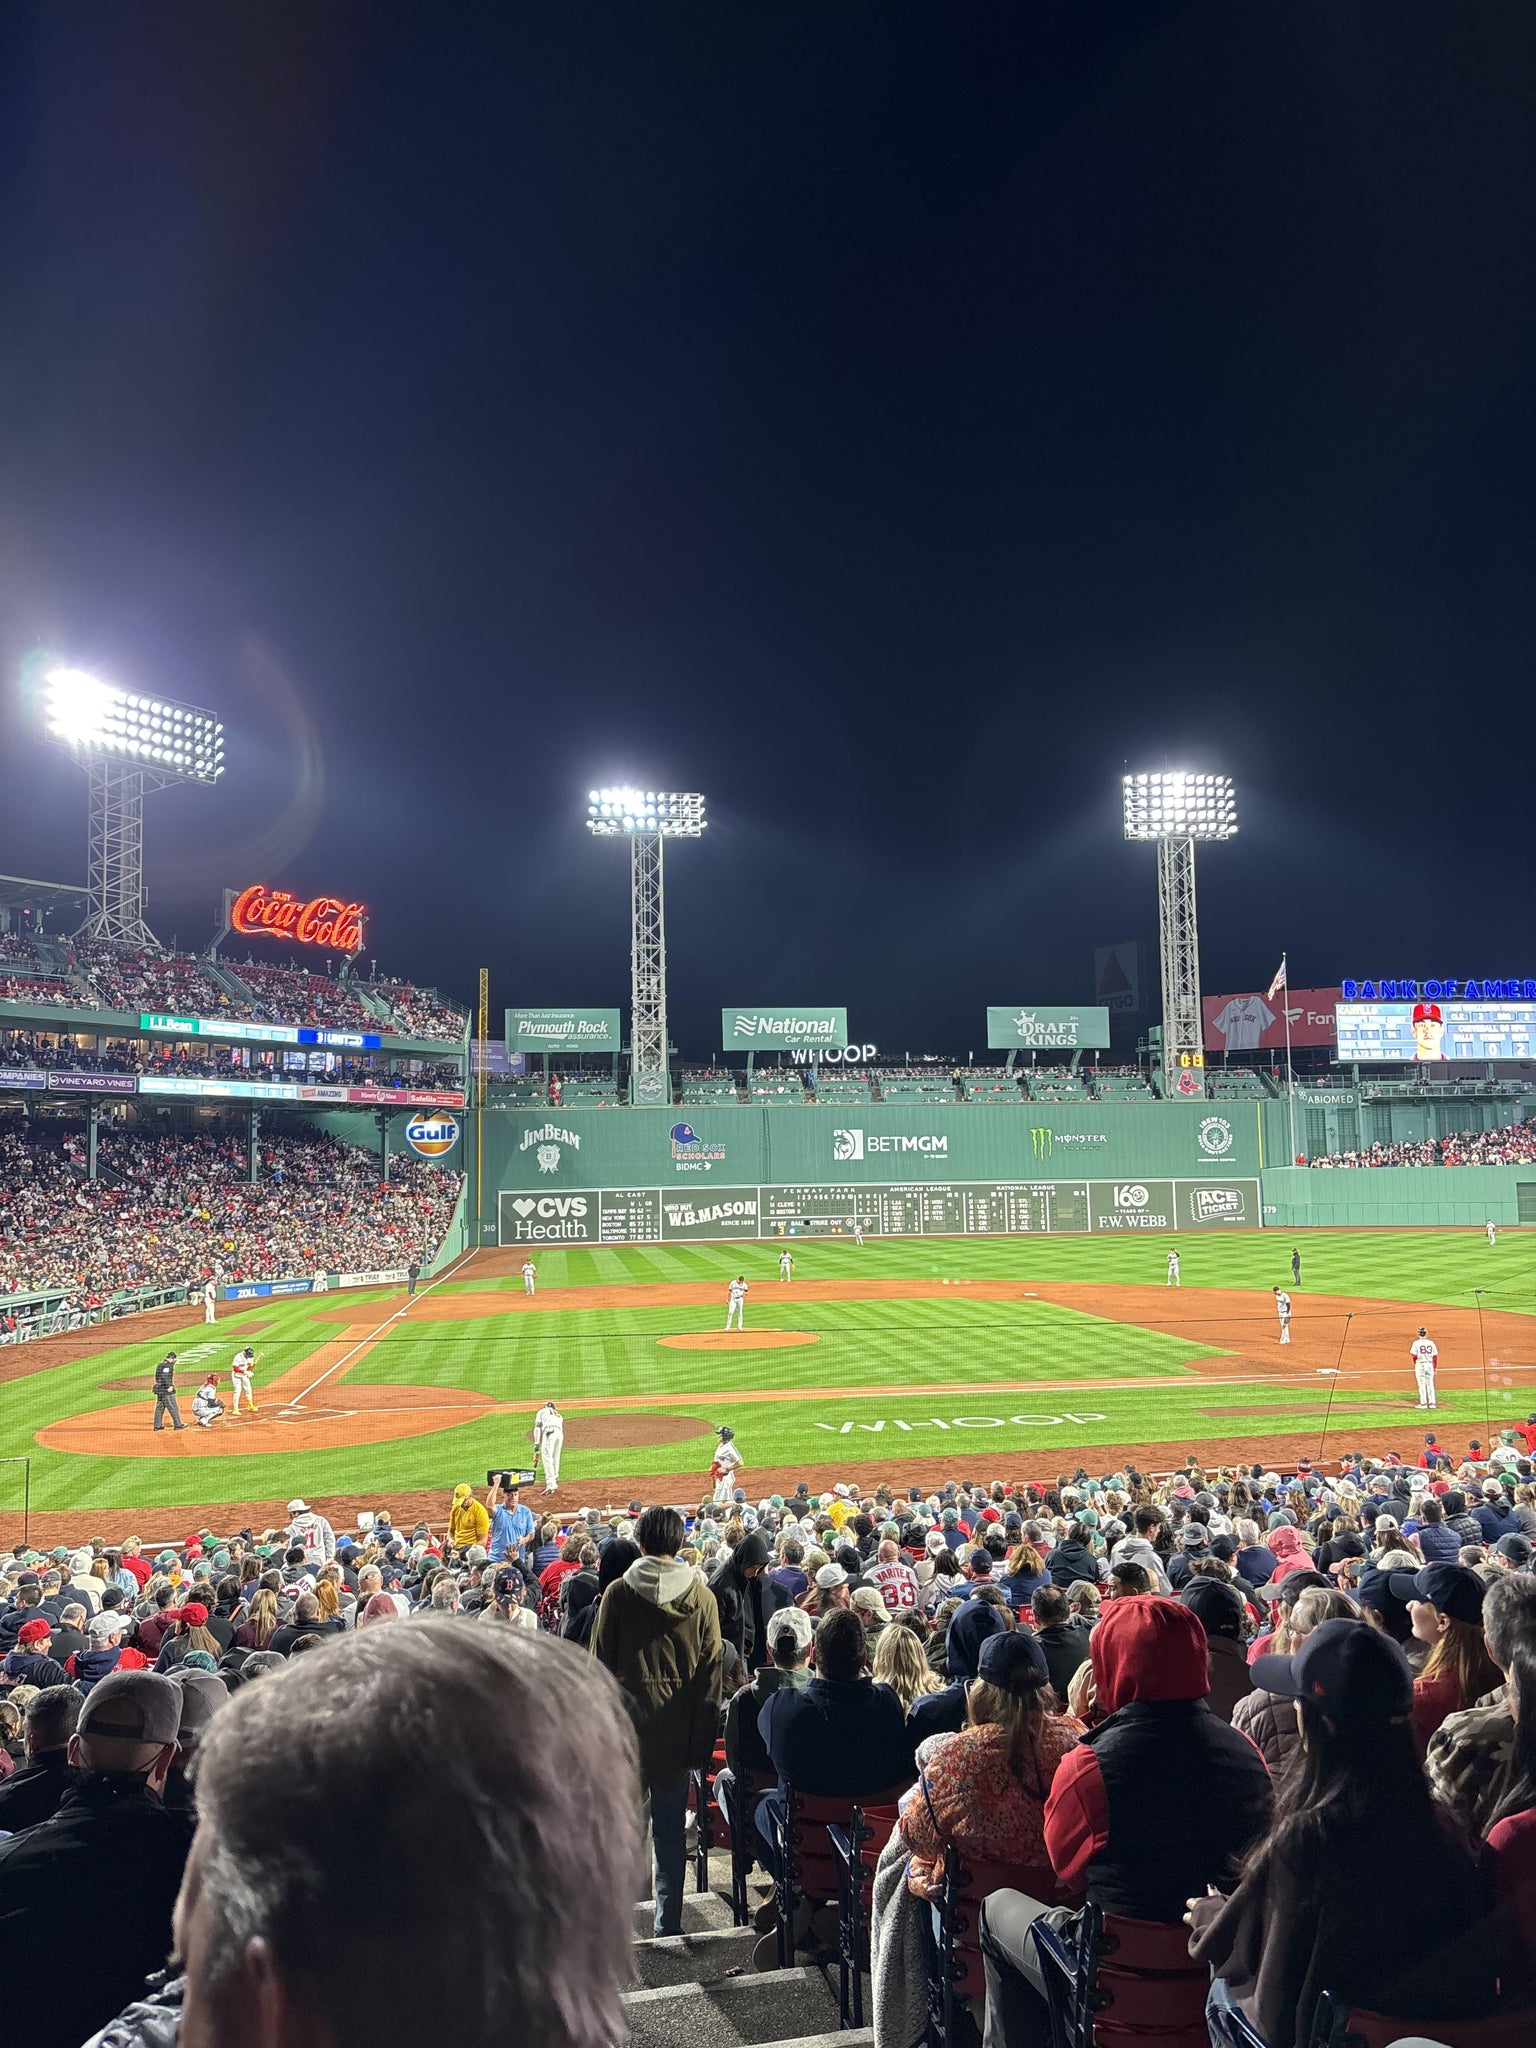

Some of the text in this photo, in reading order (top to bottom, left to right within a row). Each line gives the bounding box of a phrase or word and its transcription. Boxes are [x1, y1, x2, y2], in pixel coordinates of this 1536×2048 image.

[1342, 979, 1417, 999] BANK
[1424, 979, 1457, 999] OF
[518, 1020, 609, 1035] Plymouth Rock
[1017, 1022, 1079, 1036] DRAFT
[785, 1035, 832, 1043] Car Rental
[1025, 1034, 1078, 1046] KINGS
[792, 1044, 877, 1064] WHOOP
[1488, 1043, 1498, 1057] 0
[1516, 1043, 1526, 1057] 2
[59, 1076, 106, 1087] VINEYARD
[107, 1079, 134, 1089] VINES
[1307, 1095, 1354, 1104] ABIOMED
[408, 1124, 456, 1140] Gulf
[1054, 1134, 1108, 1143] MONSTER
[676, 1143, 726, 1152] RED SOX
[867, 1136, 948, 1152] BETMGM
[676, 1152, 726, 1160] SCHOLARS
[676, 1162, 703, 1171] BIDMC
[1201, 1190, 1238, 1206] ACE
[537, 1196, 588, 1218] CVS
[1201, 1203, 1238, 1216] TICKET
[1262, 1206, 1277, 1214] 379
[482, 1224, 496, 1232] 310
[1098, 1215, 1167, 1228] F.W. WEBB
[515, 1219, 589, 1240] Health
[778, 1226, 784, 1235] 3
[237, 1287, 258, 1299] ZOLL
[1419, 1345, 1433, 1355] 83
[813, 1413, 1107, 1433] WHOOP
[875, 1567, 911, 1583] VARITEK
[505, 1579, 513, 1591] B
[880, 1582, 915, 1608] 33
